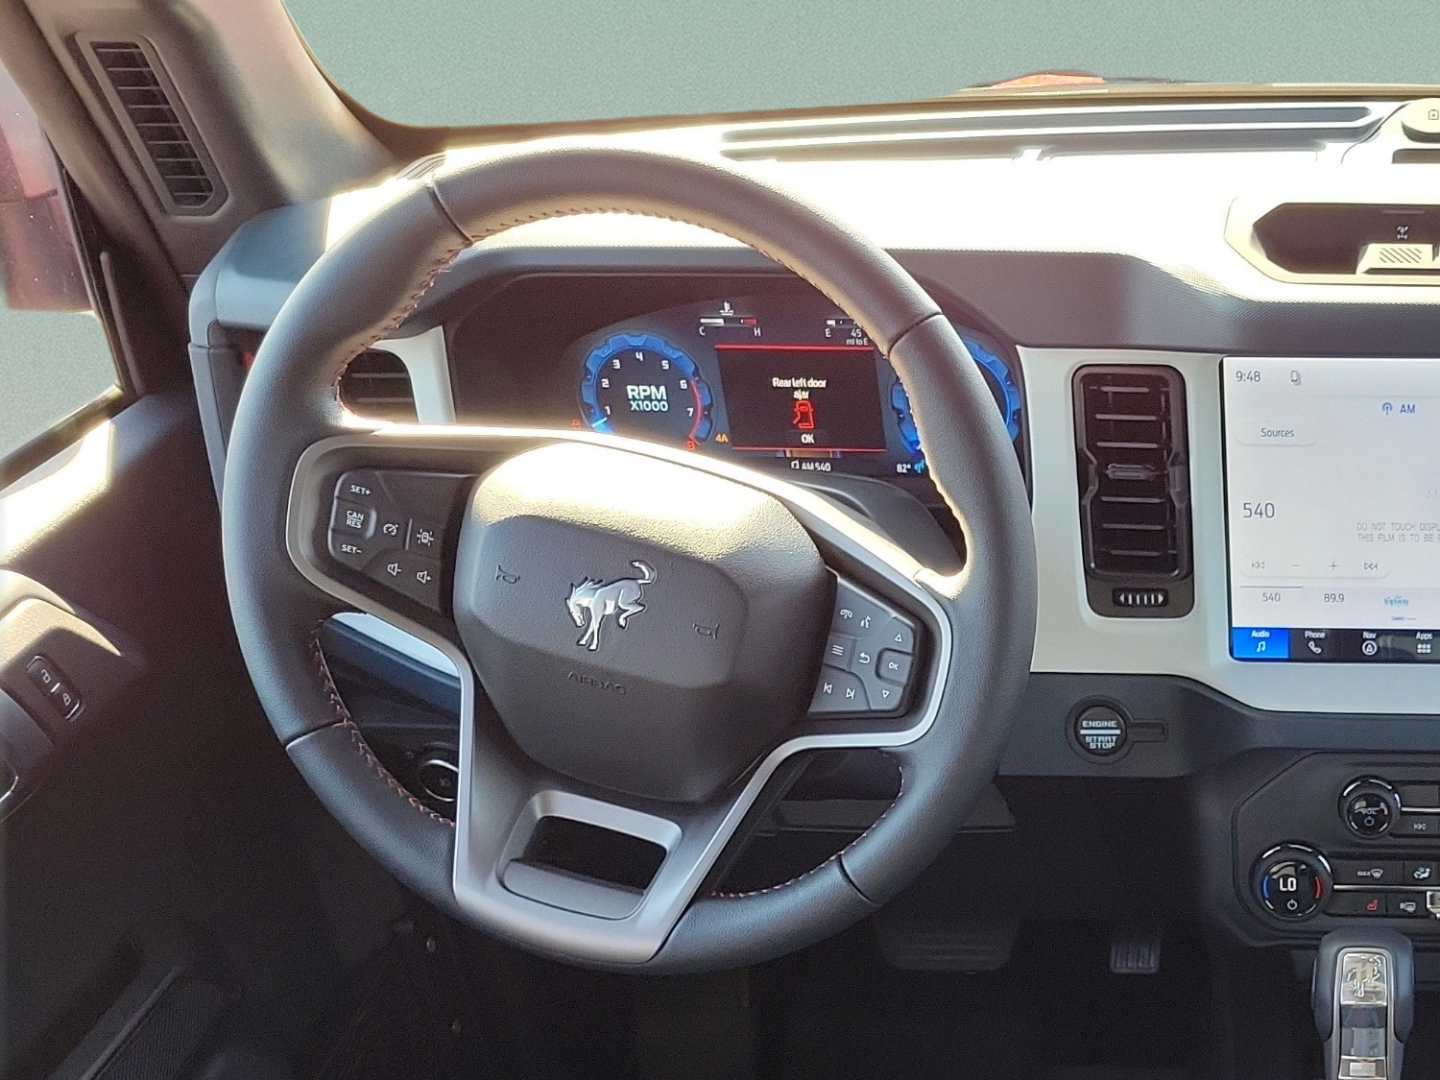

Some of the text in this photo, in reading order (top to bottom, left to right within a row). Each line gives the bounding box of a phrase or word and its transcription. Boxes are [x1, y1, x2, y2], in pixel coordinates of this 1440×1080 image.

[754, 328, 761, 337] H
[635, 351, 643, 361] 4
[612, 359, 621, 369] 3
[661, 360, 669, 370] 5
[1235, 371, 1261, 382] 9:48
[601, 378, 610, 388] 2
[808, 378, 827, 388] door
[626, 385, 667, 400] RPM
[630, 401, 668, 411] X1000
[1400, 404, 1416, 414] AM
[686, 407, 694, 417] 7
[716, 433, 728, 443] 4A
[1260, 428, 1295, 438] Sources
[350, 484, 371, 495] SET+
[1242, 502, 1275, 519] 540
[1262, 592, 1281, 602] 540
[1324, 593, 1345, 603] 89.9
[1251, 630, 1270, 638] Audio
[1305, 631, 1326, 639] Phone
[1362, 631, 1377, 639] Nav
[1416, 632, 1433, 640] Apps
[888, 662, 899, 670] OK
[1082, 720, 1117, 728] ENGINE
[1085, 735, 1117, 743] START
[1089, 742, 1116, 750] STOP
